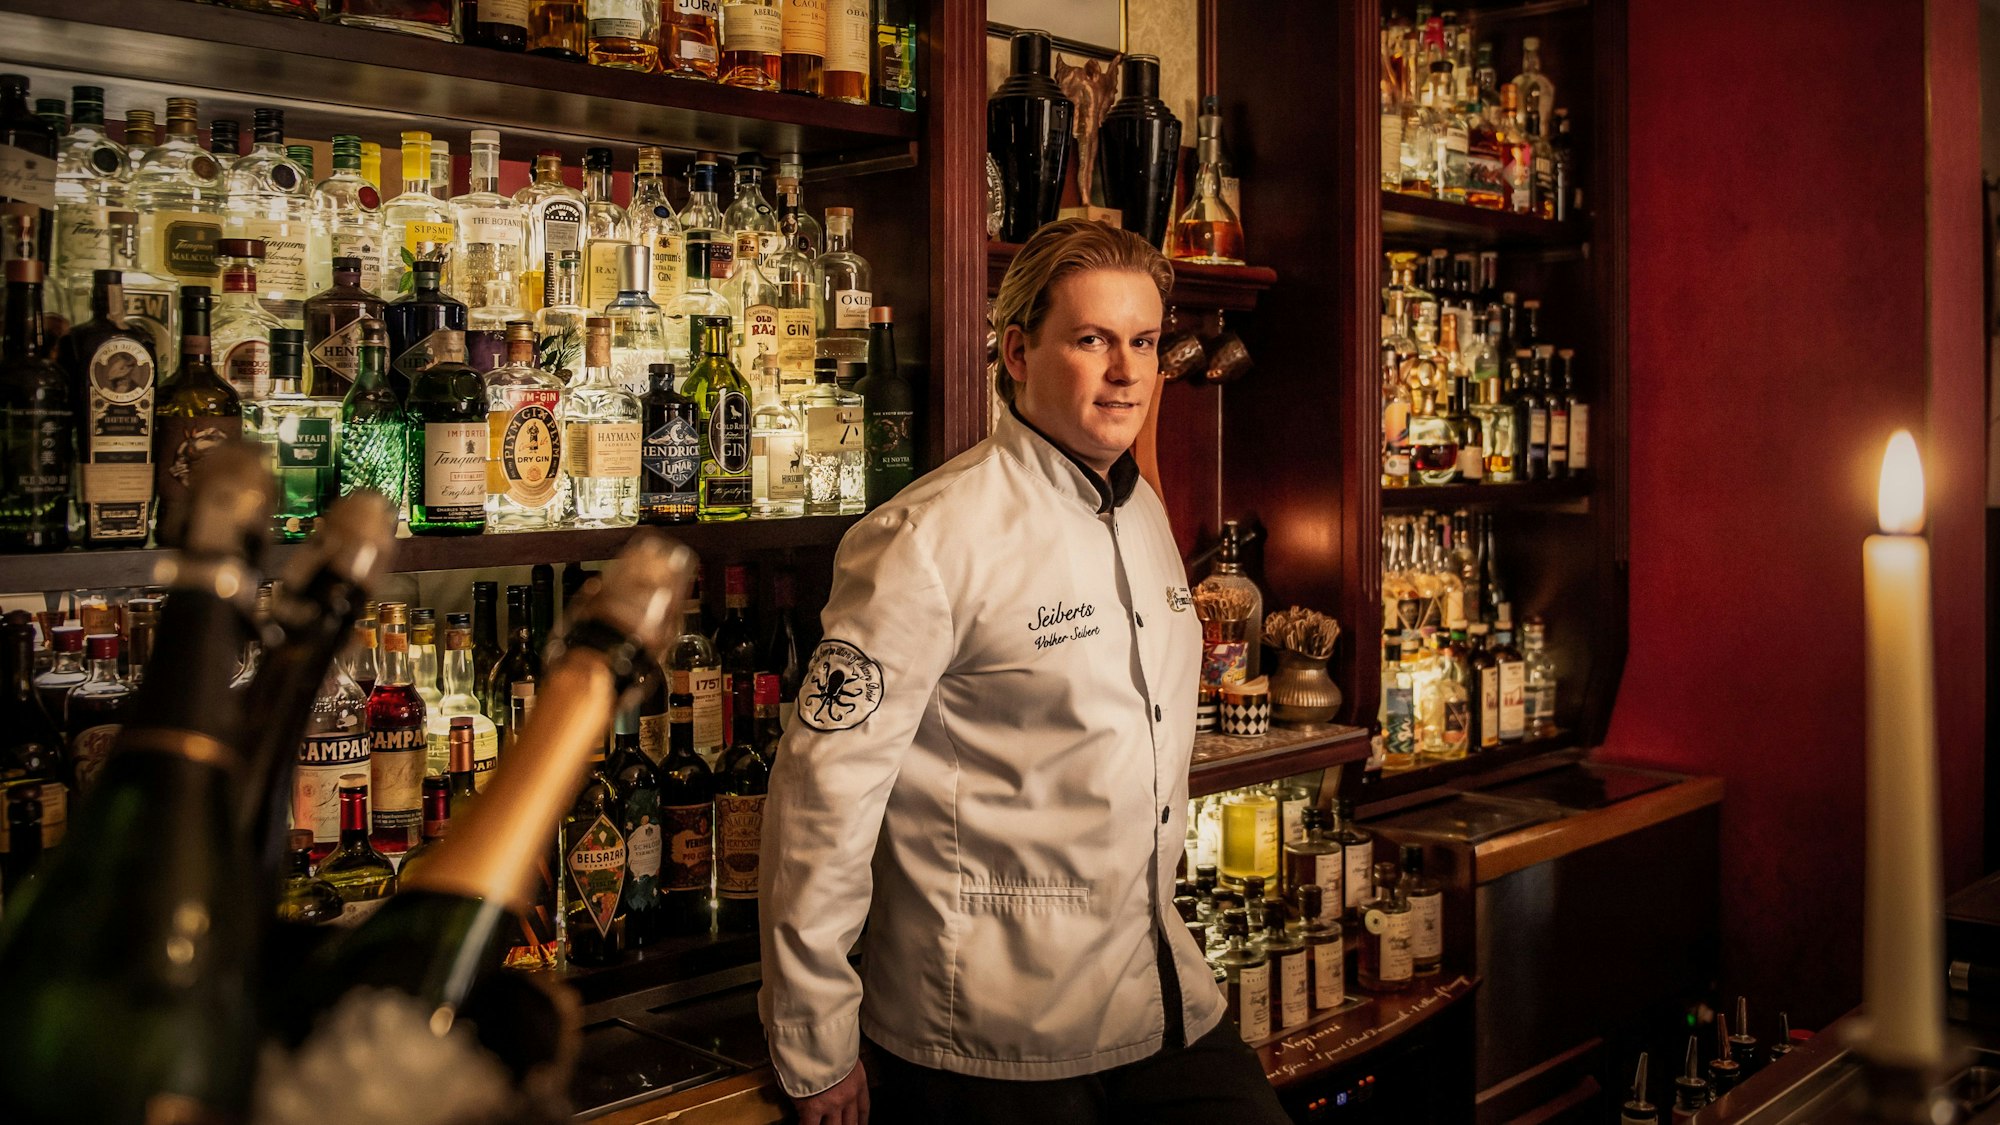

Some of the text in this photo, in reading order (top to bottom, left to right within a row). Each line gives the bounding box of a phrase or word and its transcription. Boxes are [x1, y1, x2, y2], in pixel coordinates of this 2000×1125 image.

[679, 0, 719, 15] JURA
[792, 0, 819, 11] CAOL
[472, 216, 490, 226] THE
[657, 270, 672, 282] GIN
[755, 315, 772, 323] OLD
[751, 323, 777, 336] RAJ
[786, 324, 810, 337] GIN
[230, 360, 269, 369] BURROUG
[294, 434, 328, 443] AYFAIR
[504, 407, 561, 460] PLYM GIN PLYM
[722, 442, 747, 457] GIN
[517, 455, 550, 464] DRY GIN
[661, 458, 693, 479] LUNAR
[672, 472, 689, 482] GIN
[1027, 601, 1096, 631] Seiberts
[1069, 624, 1101, 641] Seibert
[576, 847, 624, 864] BELSAZAR
[1274, 1022, 1342, 1055] Negroni
